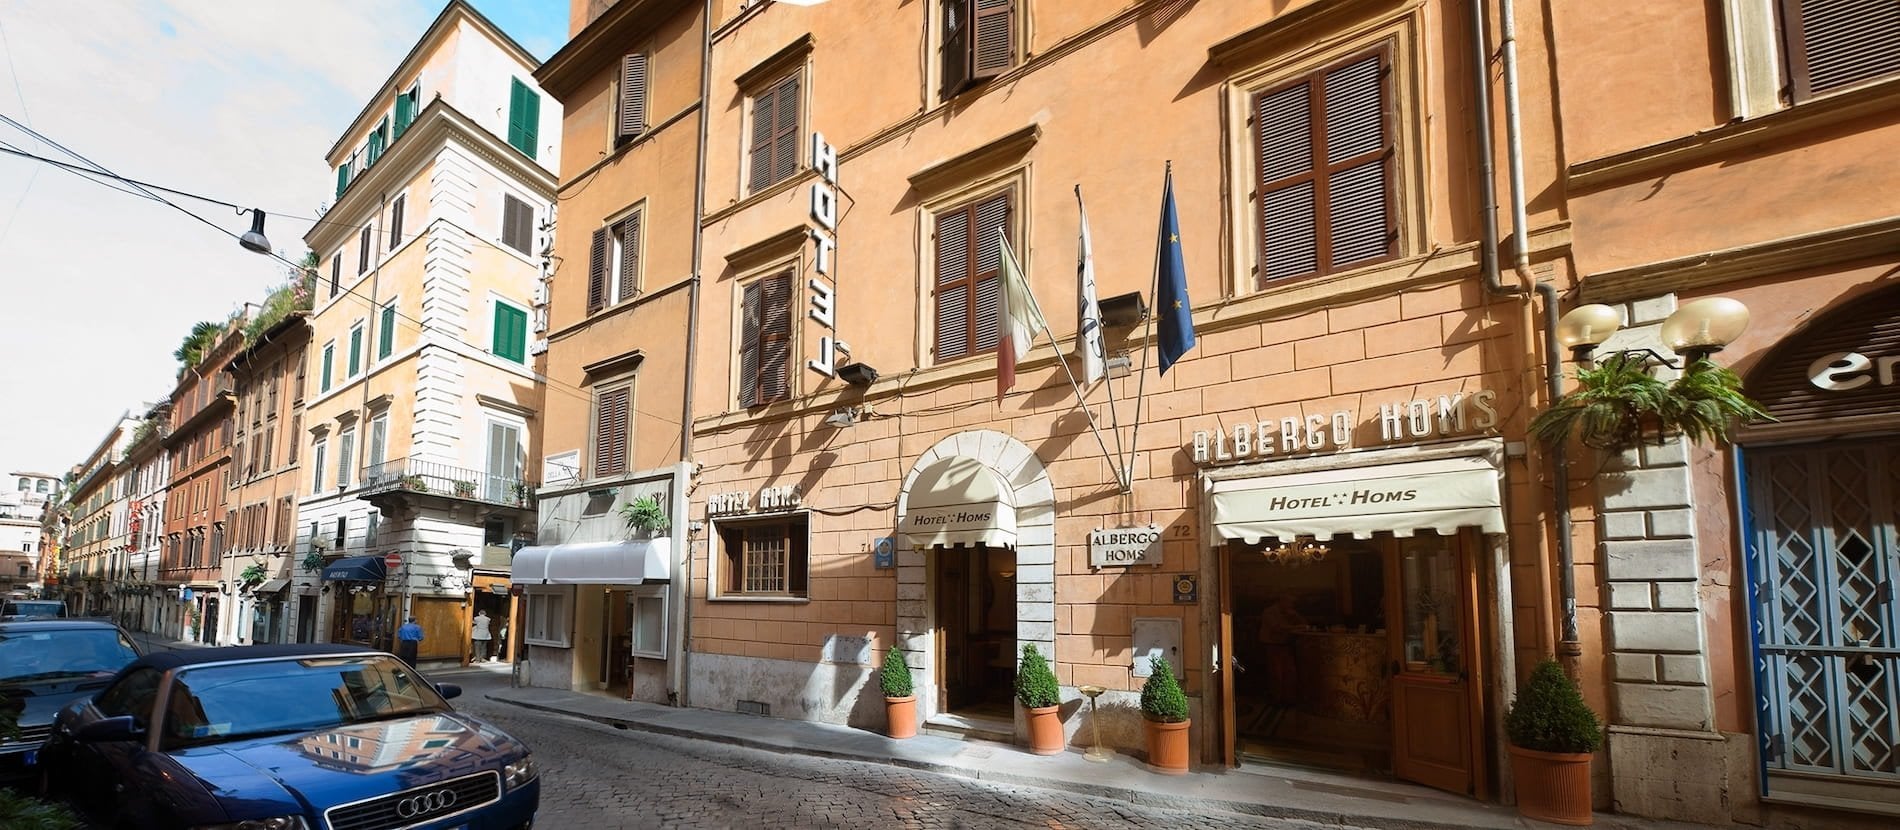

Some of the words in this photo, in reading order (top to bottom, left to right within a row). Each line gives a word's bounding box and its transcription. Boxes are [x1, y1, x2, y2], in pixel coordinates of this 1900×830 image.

[1192, 409, 1352, 464] ALBERGO
[1379, 389, 1498, 442] HOMS
[708, 490, 751, 514] HOTEL
[760, 483, 802, 509] HOMS
[1173, 524, 1191, 537] 72
[1092, 532, 1160, 546] ALBERGO
[1105, 549, 1146, 561] HOMS
